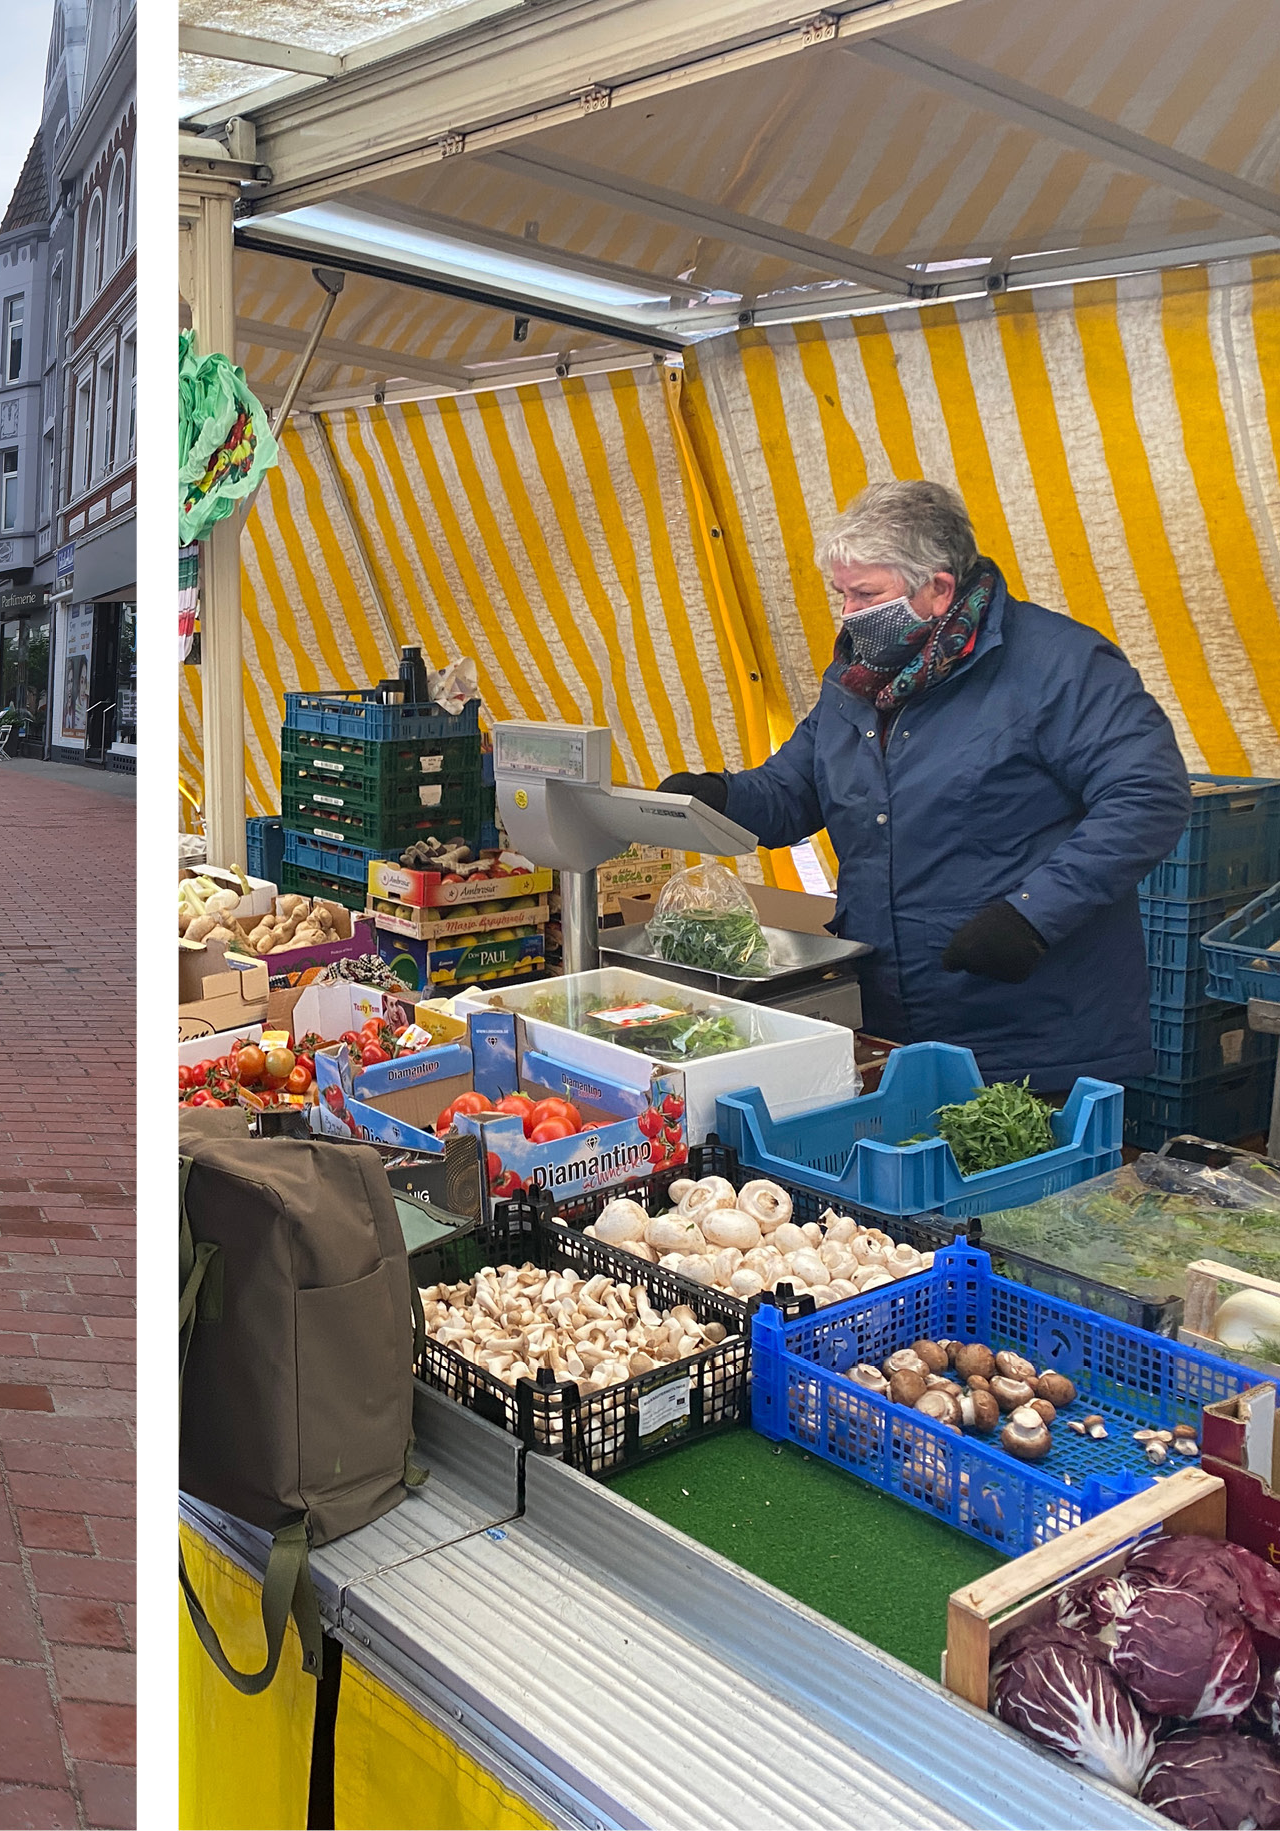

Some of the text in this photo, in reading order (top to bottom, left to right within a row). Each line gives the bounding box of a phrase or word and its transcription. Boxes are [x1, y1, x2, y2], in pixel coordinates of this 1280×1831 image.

[1, 591, 37, 608] Parfümerie
[480, 950, 510, 966] PAUL
[354, 1002, 380, 1013] Tasty Tom
[388, 1060, 439, 1081] Diamantino
[561, 1073, 602, 1098] Diamantino
[533, 1141, 652, 1188] Diamantino
